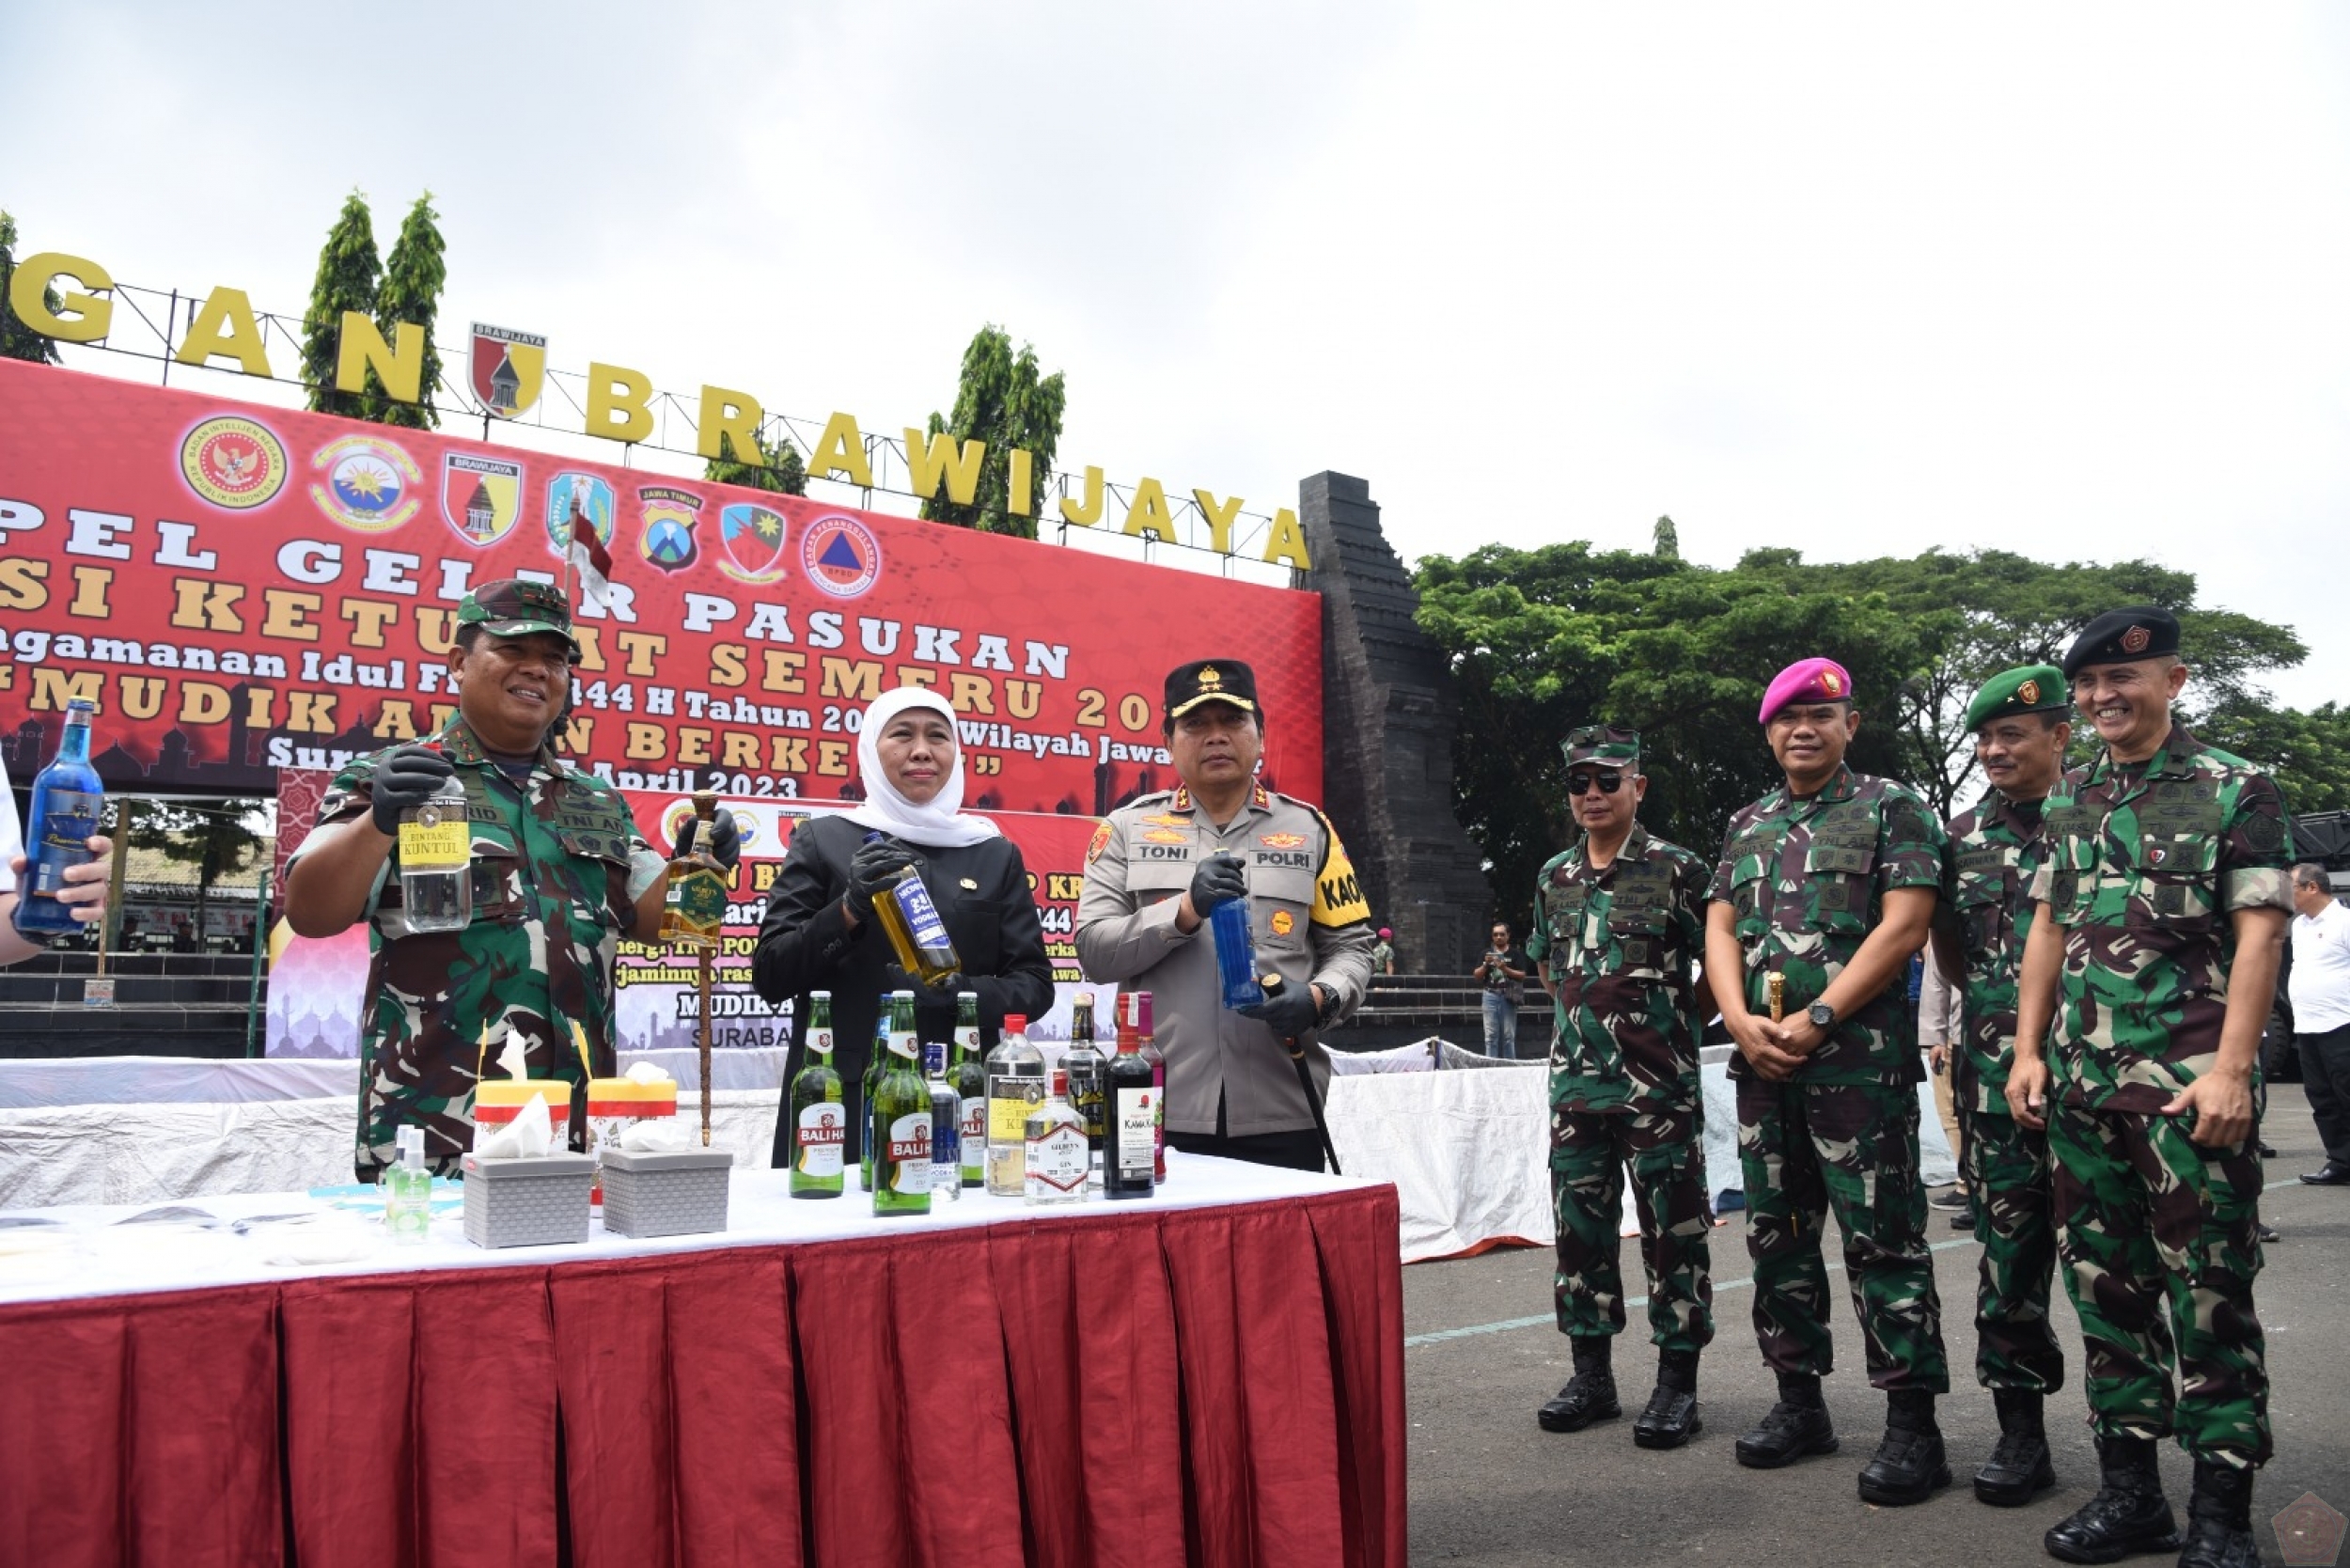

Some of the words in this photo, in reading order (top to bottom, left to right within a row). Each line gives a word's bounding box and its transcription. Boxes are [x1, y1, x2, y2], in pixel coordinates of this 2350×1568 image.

[476, 324, 543, 347] BRAWIJAYA
[189, 430, 209, 457] BADAN
[259, 434, 280, 471] NEGARA
[454, 457, 513, 476] BRAWIJAYA
[586, 362, 1311, 571] BRAWIJAYA
[189, 465, 227, 502] REPUBLIK
[227, 478, 276, 503] INDONESIA
[643, 489, 668, 500] JAWA
[669, 490, 699, 508] TIMUR
[172, 578, 667, 679] KETUAT
[682, 592, 1069, 680] PASUKAN
[301, 651, 405, 690] Idul
[646, 686, 675, 715] H
[683, 691, 811, 730] Tahun
[822, 705, 862, 734] 20
[959, 719, 1090, 760] Wilayah
[1098, 735, 1172, 765] Jawa
[708, 770, 799, 796] 2023
[564, 814, 594, 827] TNI
[410, 832, 450, 842] BINTANG
[1818, 837, 1840, 846] TNI
[404, 842, 459, 855] KUNTUL
[1139, 846, 1189, 860] TONI
[1257, 853, 1309, 868] POLRI
[801, 1129, 831, 1141] BALI
[963, 1121, 983, 1135] ALI
[893, 1143, 923, 1156] BALI
